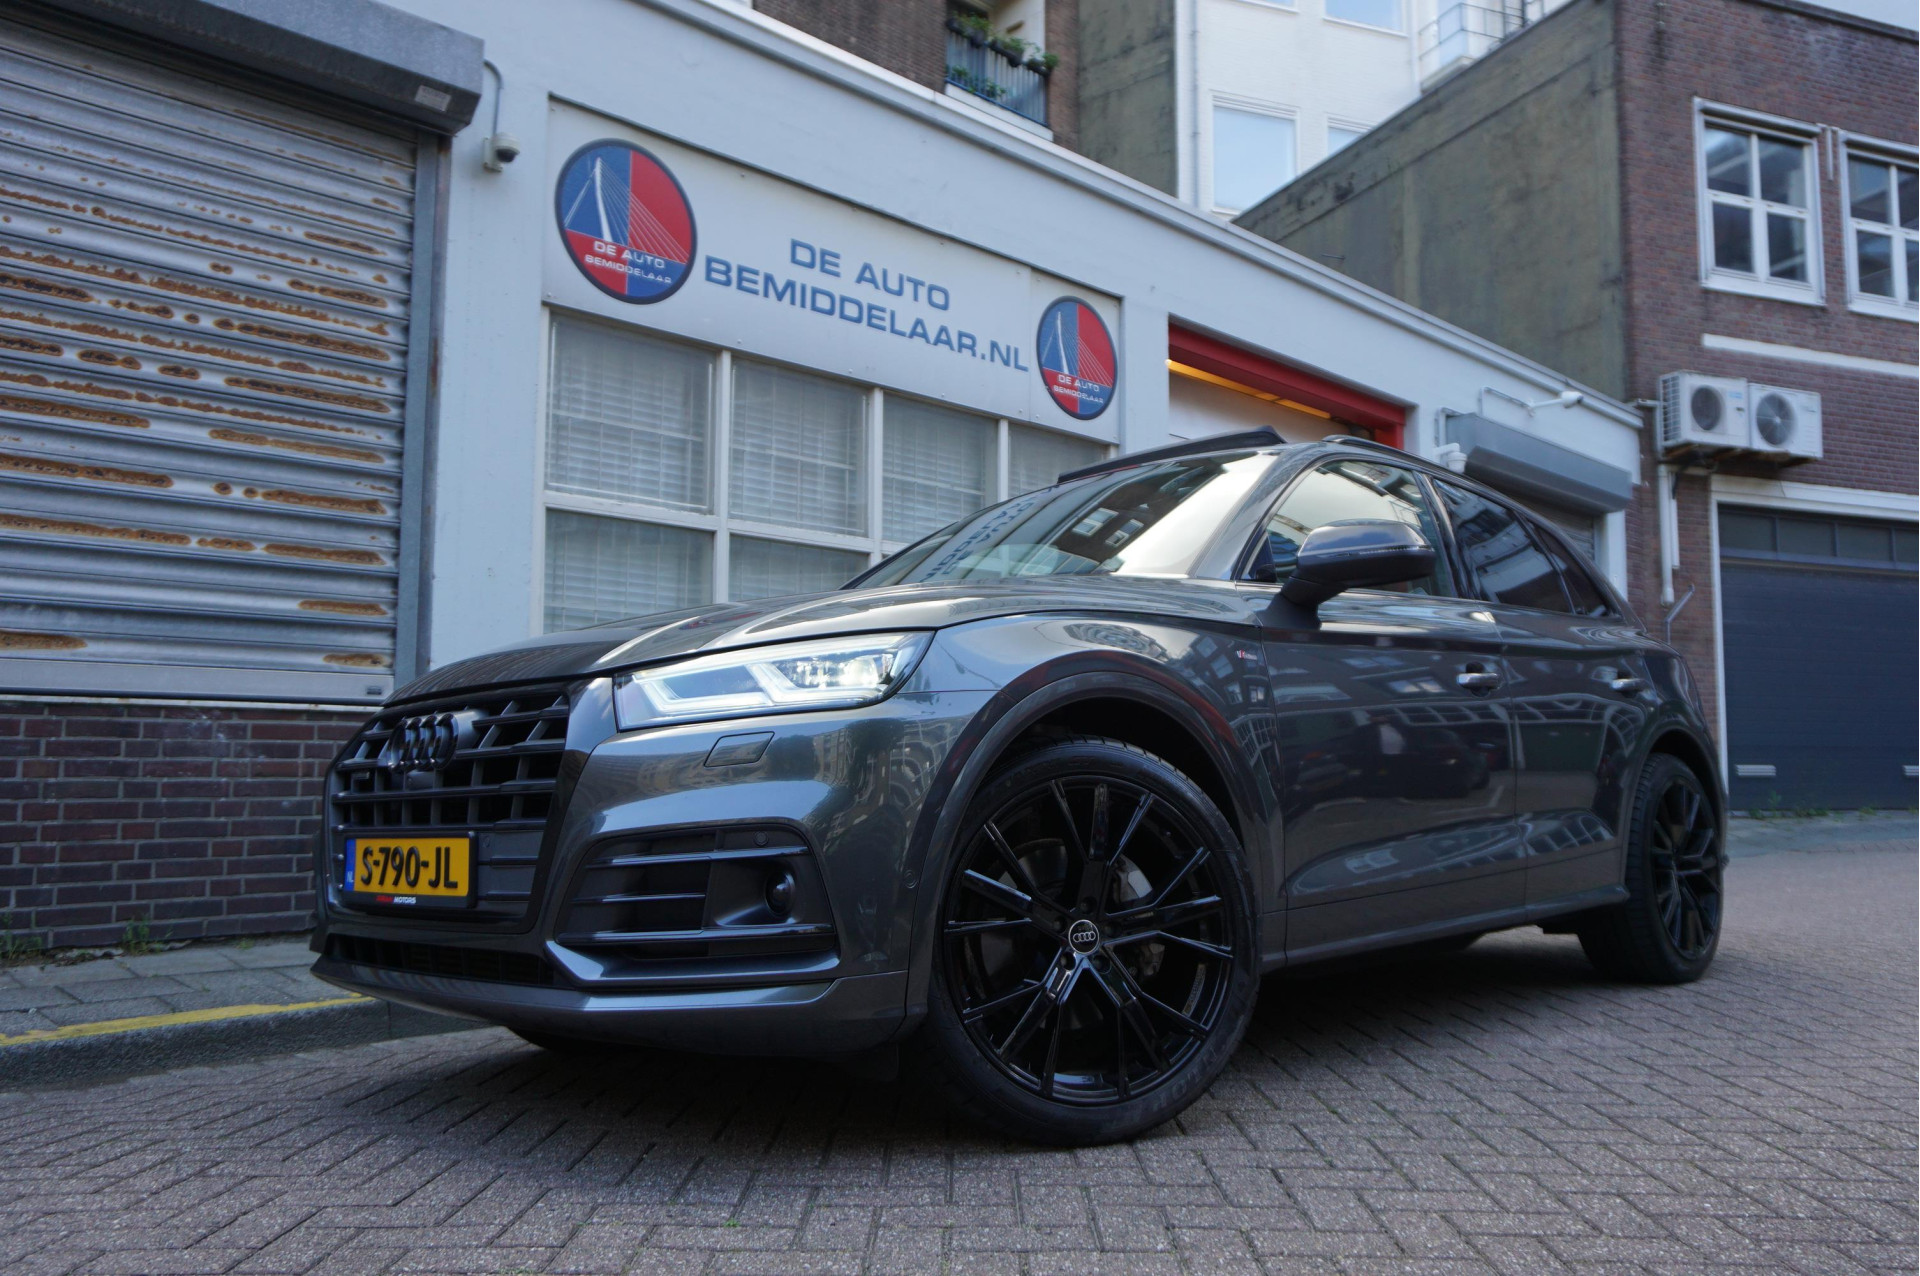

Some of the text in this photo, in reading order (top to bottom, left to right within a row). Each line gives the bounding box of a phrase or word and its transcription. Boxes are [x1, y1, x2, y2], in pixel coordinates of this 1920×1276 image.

[584, 254, 672, 284] BEMIDDELAAR
[593, 240, 665, 269] DE AUTO
[790, 238, 950, 311] DE AUTO
[705, 254, 1029, 373] BEMIDDELAAR.NL
[1057, 374, 1100, 392] DE AUTO
[360, 846, 458, 889] S-790-JL
